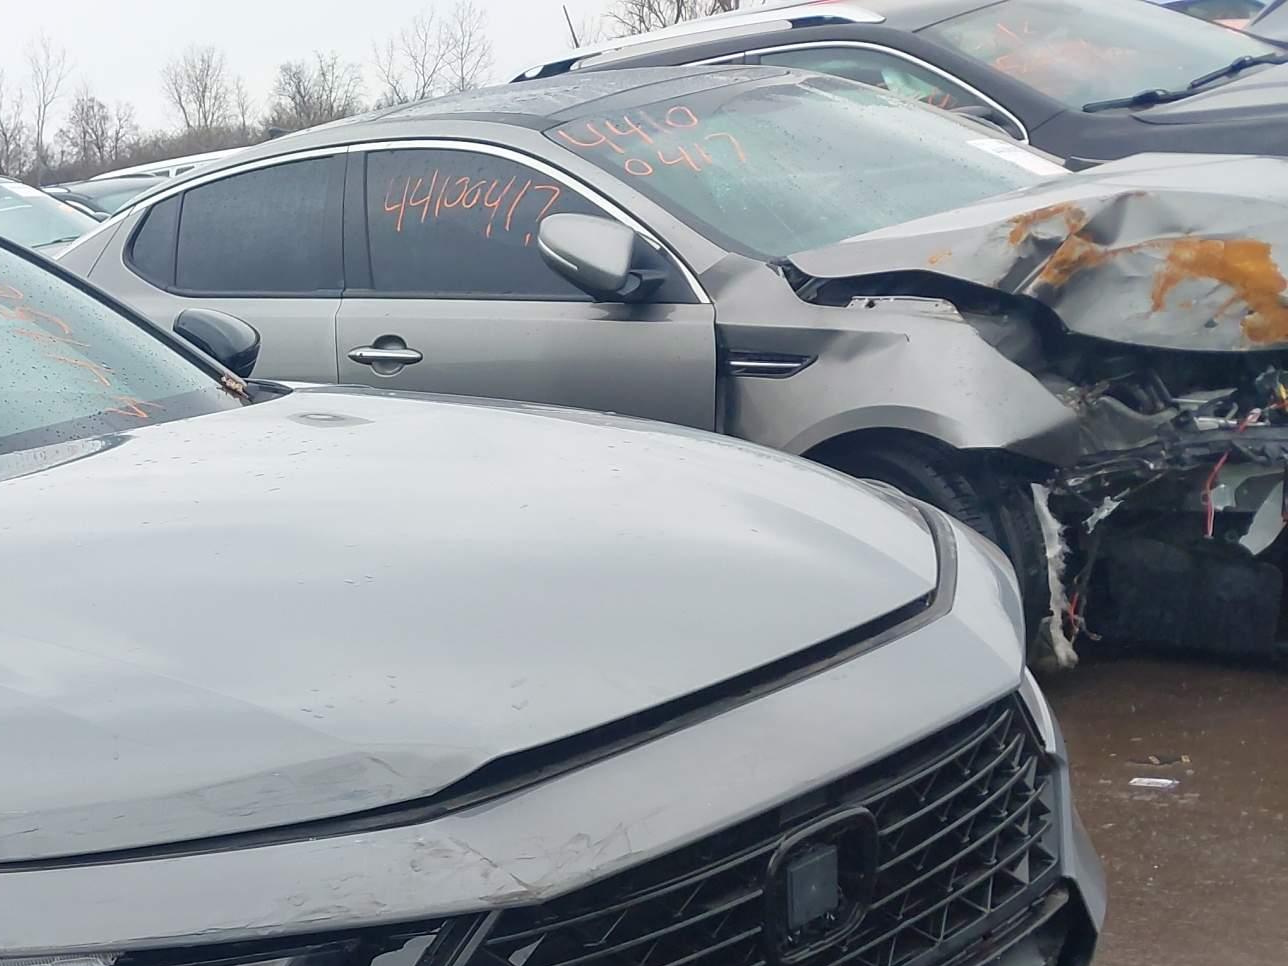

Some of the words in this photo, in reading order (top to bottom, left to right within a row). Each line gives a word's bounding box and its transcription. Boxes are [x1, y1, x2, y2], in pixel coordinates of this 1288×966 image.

[558, 106, 699, 154] 4410
[624, 132, 747, 177] 0417
[384, 168, 561, 247] 44100417
